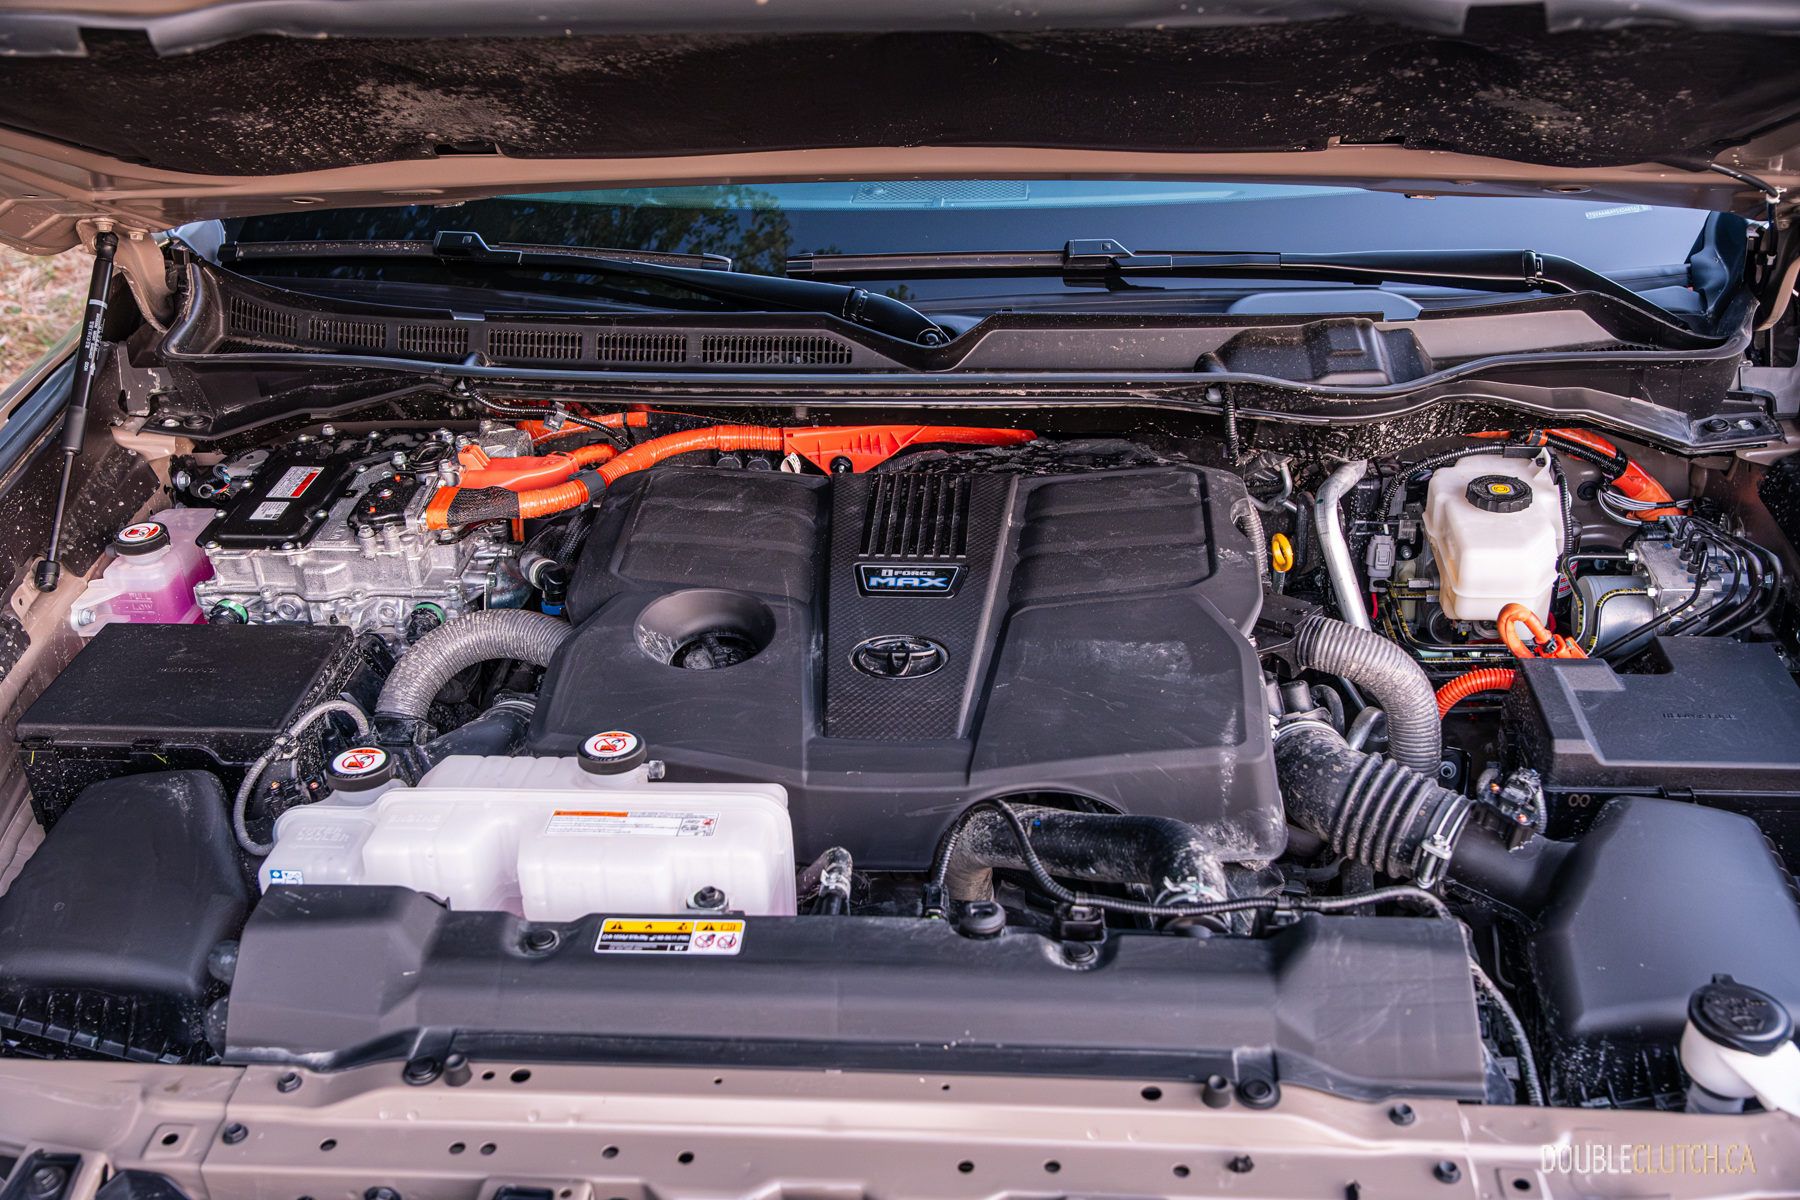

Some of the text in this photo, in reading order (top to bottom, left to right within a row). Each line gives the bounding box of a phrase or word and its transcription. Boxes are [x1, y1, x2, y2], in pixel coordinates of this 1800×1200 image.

[869, 576, 948, 587] MAX
[129, 592, 152, 600] FULL
[131, 603, 153, 611] LOW
[389, 814, 442, 823] ENGINE
